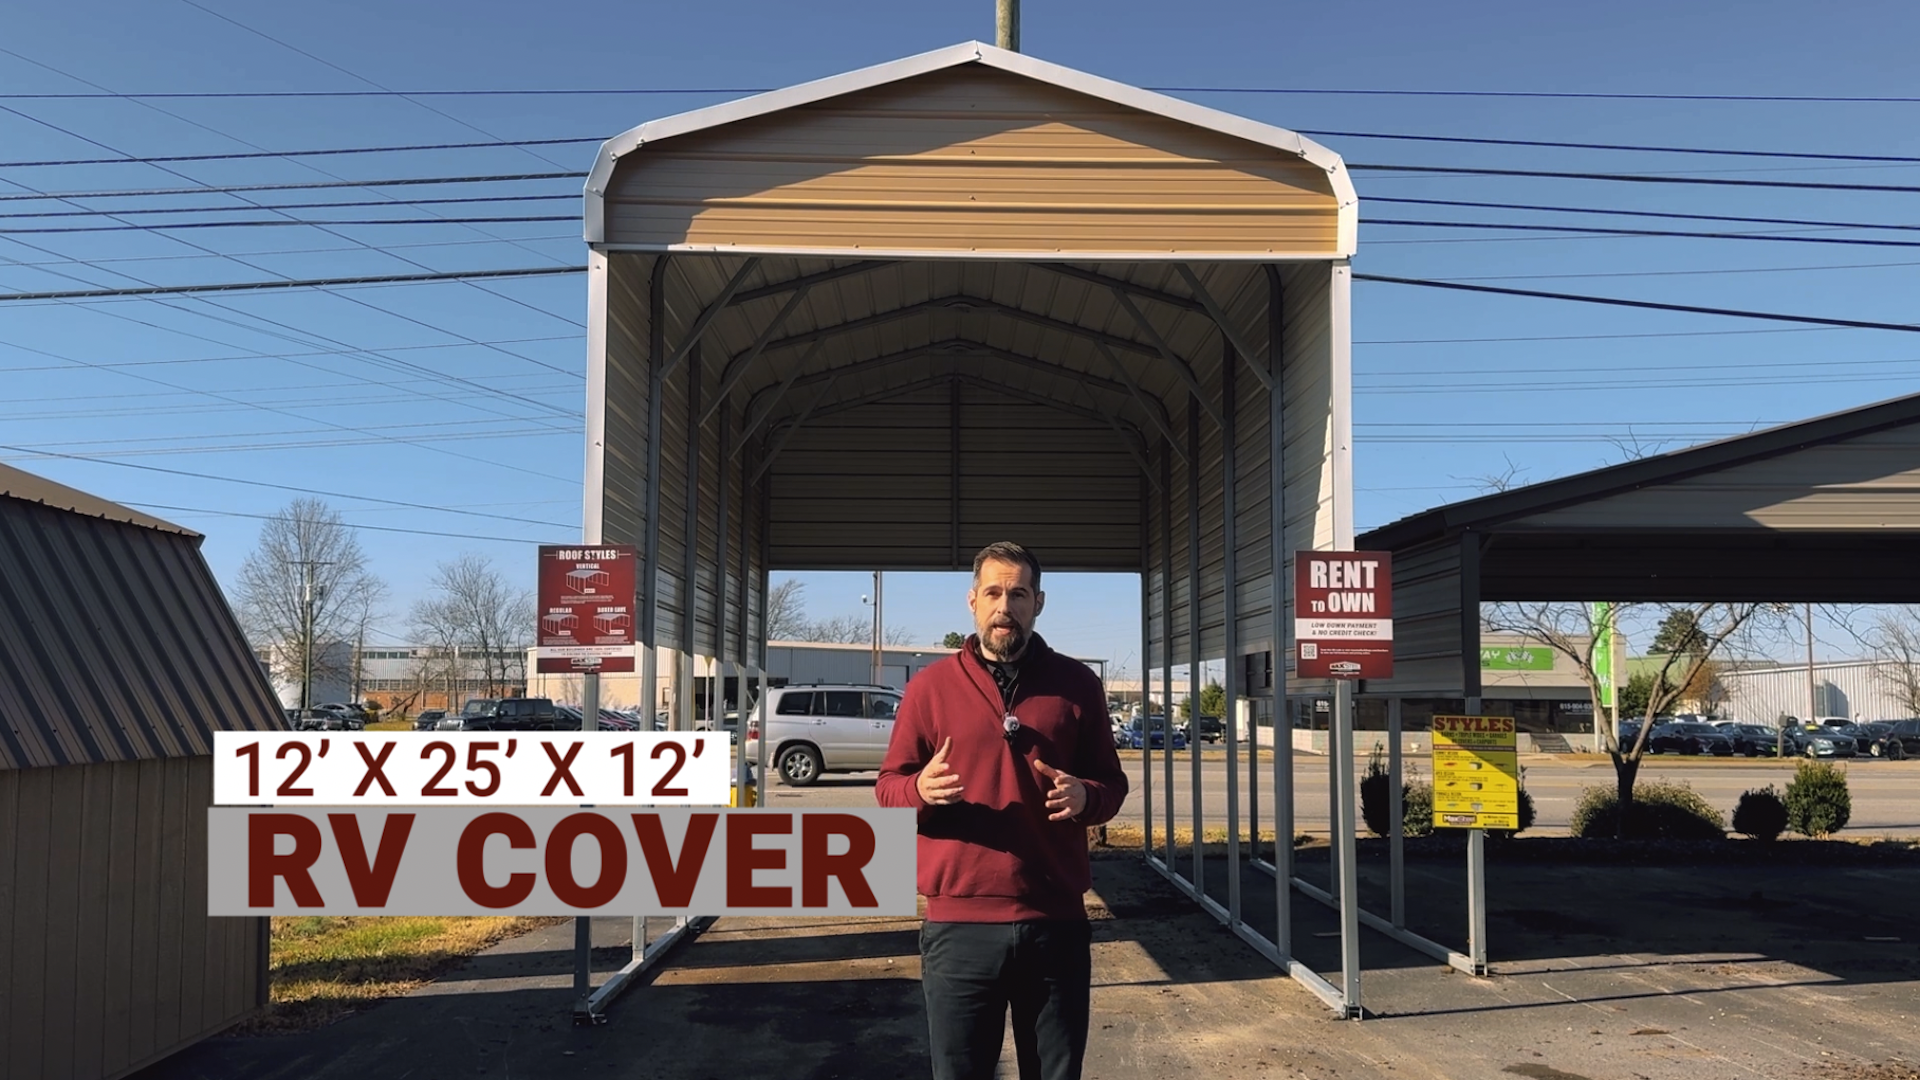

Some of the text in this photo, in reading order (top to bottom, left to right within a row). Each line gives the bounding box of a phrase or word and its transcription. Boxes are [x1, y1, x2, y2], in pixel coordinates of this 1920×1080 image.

[558, 549, 617, 561] ROOF STYLES
[1310, 560, 1379, 589] RENT
[1310, 591, 1376, 613] TO OWN
[1434, 716, 1514, 732] STYLES
